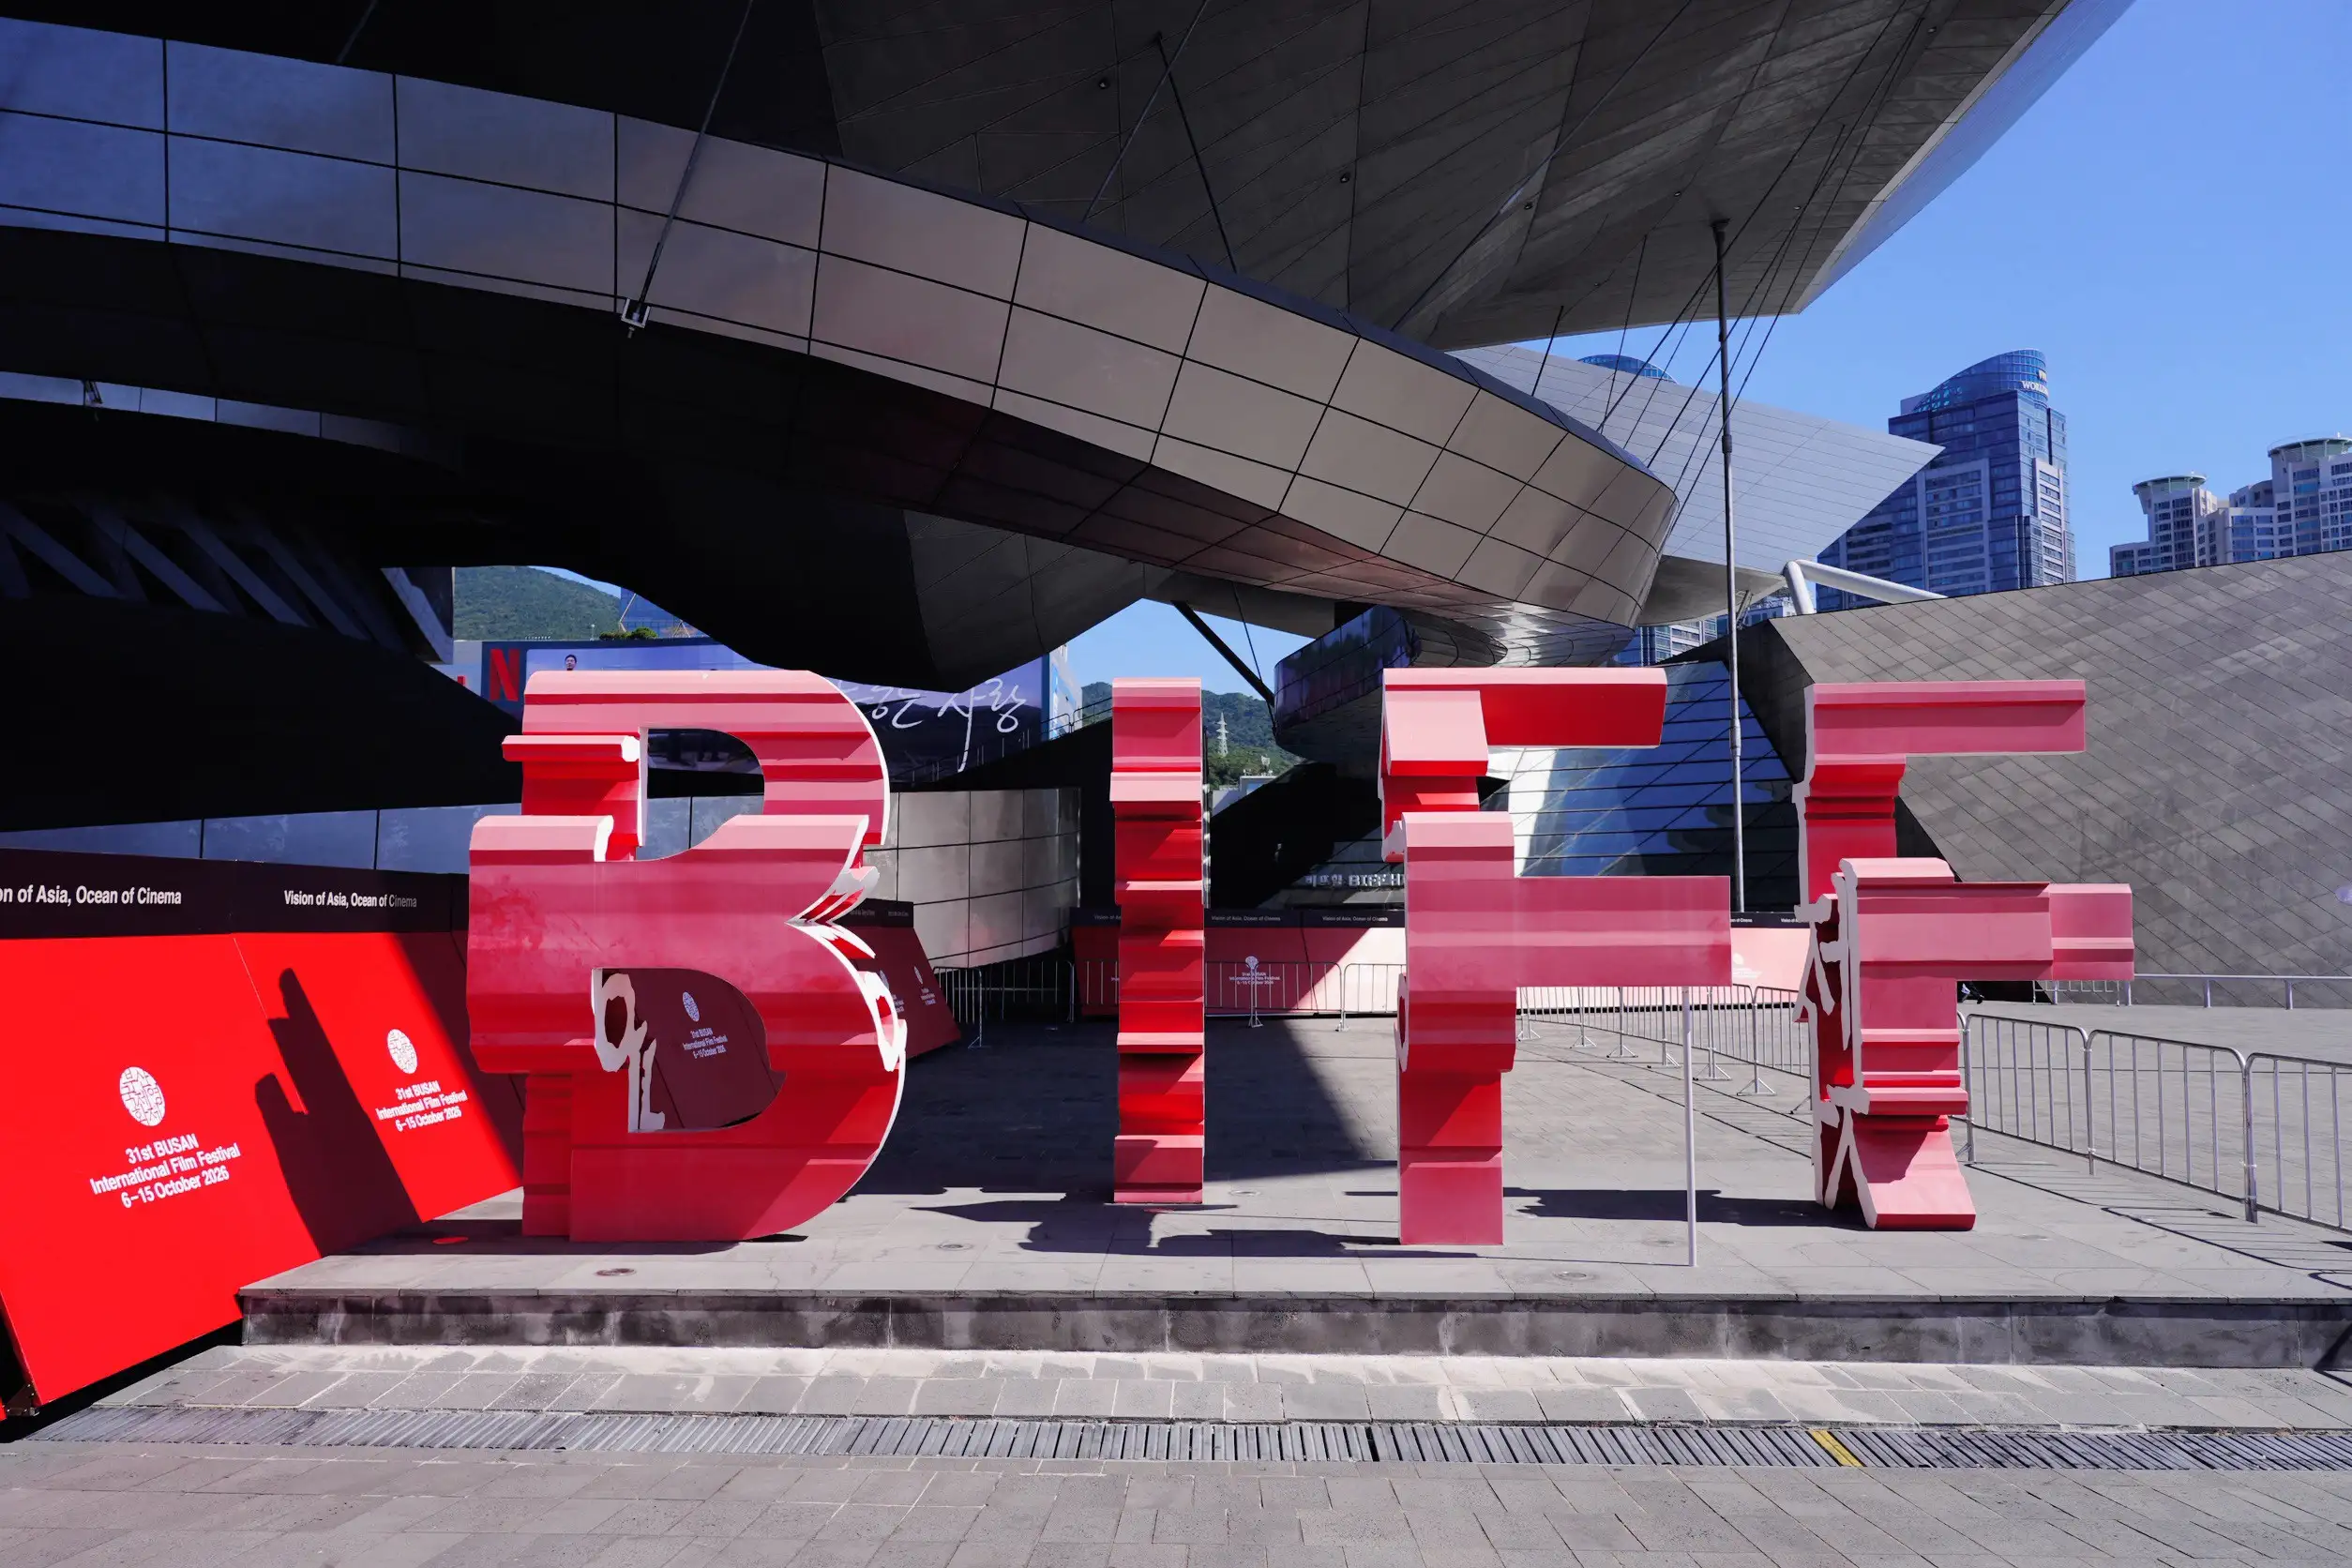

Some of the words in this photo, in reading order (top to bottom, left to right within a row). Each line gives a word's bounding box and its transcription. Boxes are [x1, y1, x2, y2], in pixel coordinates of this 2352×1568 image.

[938, 678, 1027, 773] 사랑
[17, 884, 34, 903] of
[36, 884, 71, 907] Asia,
[76, 885, 118, 904] Ocean
[121, 887, 135, 904] of
[137, 887, 182, 905] Cinema
[284, 890, 314, 906] Vision
[316, 892, 326, 906] of
[326, 892, 349, 909] Asia,
[351, 892, 377, 908] Ocean
[379, 894, 387, 908] of
[388, 894, 417, 908] Cinema
[375, 1099, 425, 1121] International
[423, 1096, 442, 1109] Film
[439, 1090, 468, 1106] Festival
[395, 1087, 415, 1101] 31st
[412, 1080, 442, 1097] BUSAN
[415, 1110, 445, 1127] October
[444, 1106, 462, 1120] 2026
[125, 1144, 155, 1165] 31st
[153, 1133, 200, 1158] BUSAN
[90, 1161, 172, 1195] International
[169, 1155, 198, 1174] Film
[196, 1142, 241, 1167] Festival
[154, 1173, 202, 1199] October
[201, 1165, 230, 1186] 2026
